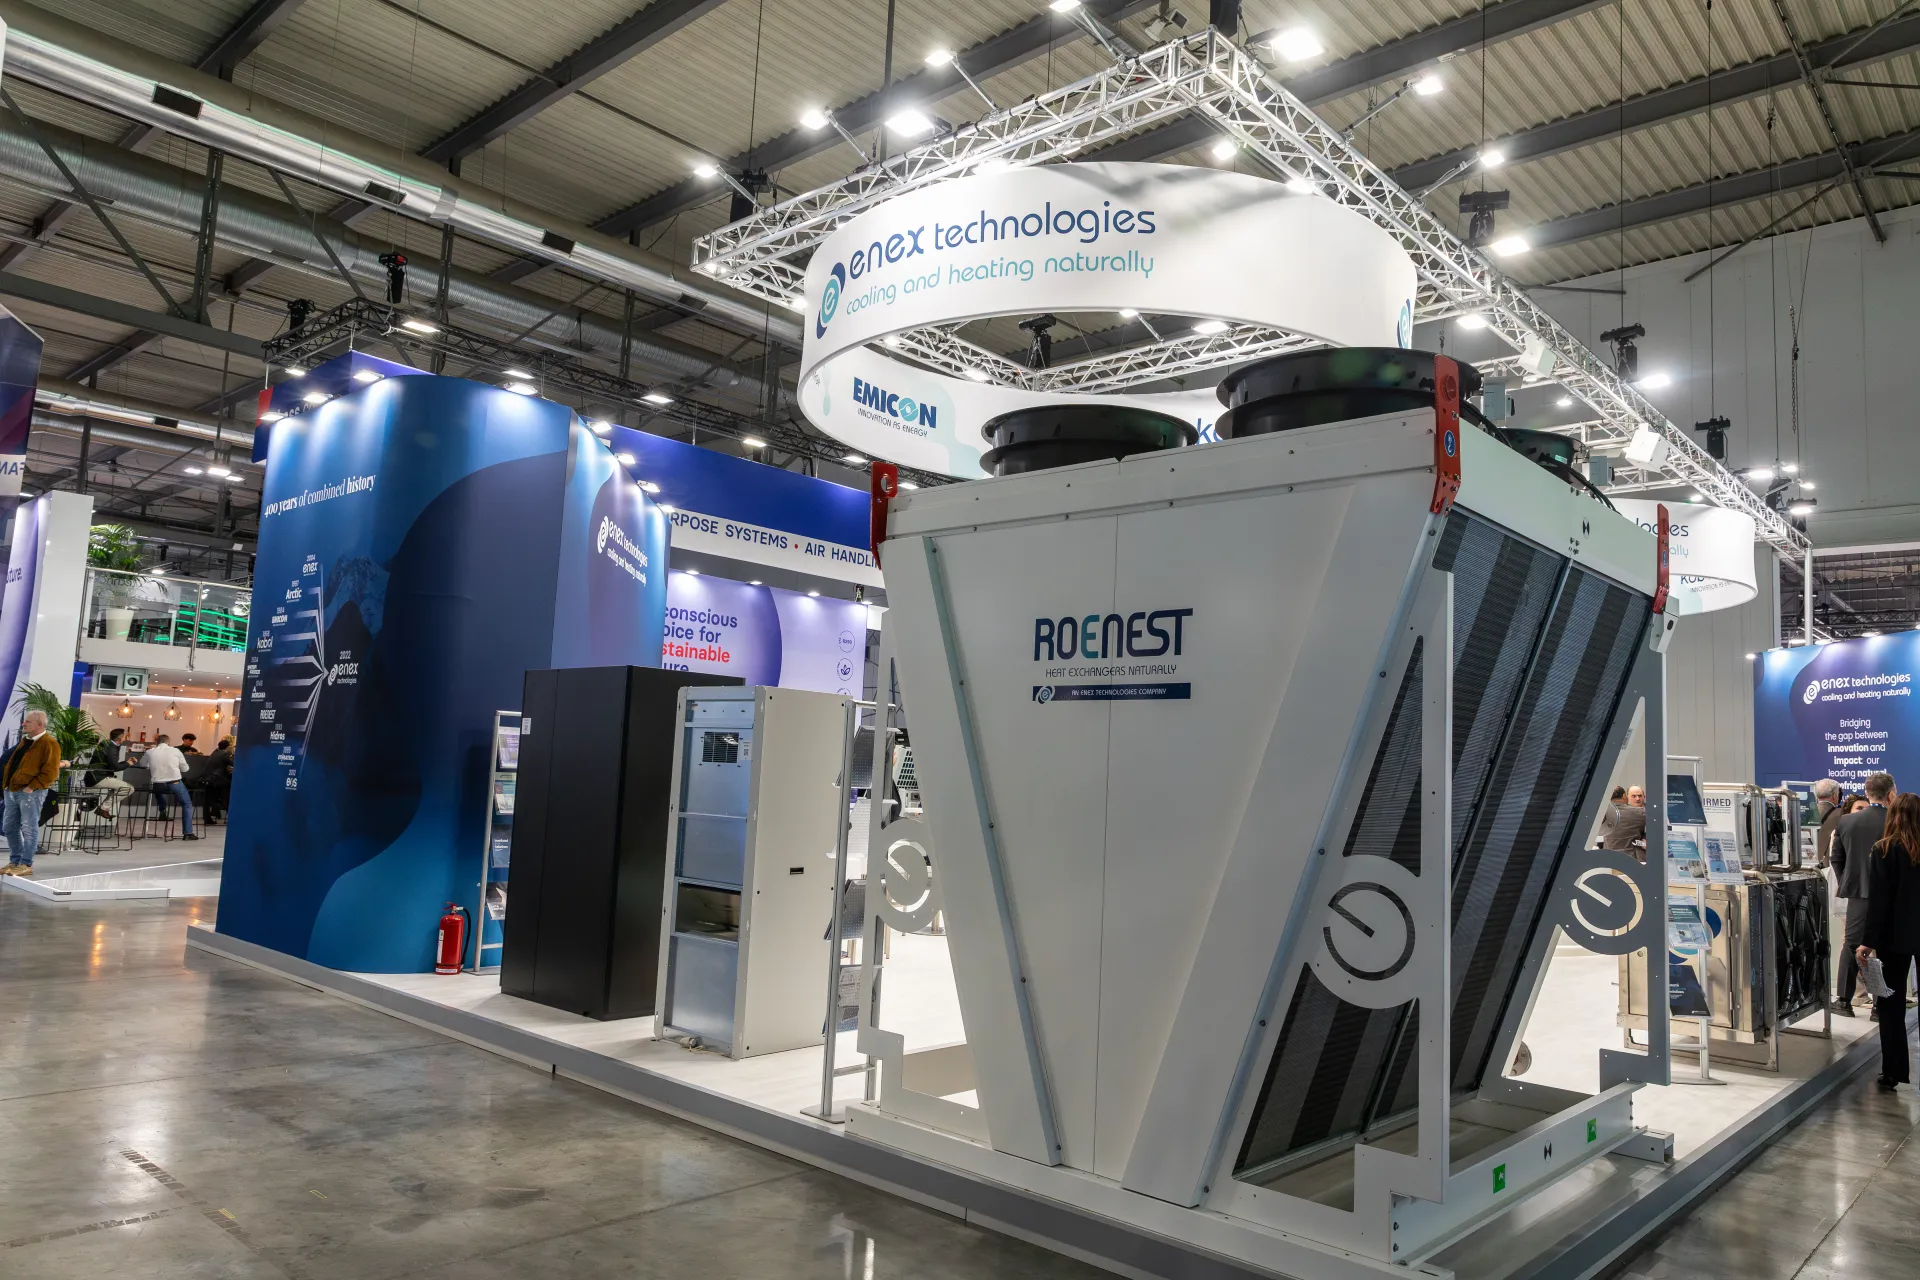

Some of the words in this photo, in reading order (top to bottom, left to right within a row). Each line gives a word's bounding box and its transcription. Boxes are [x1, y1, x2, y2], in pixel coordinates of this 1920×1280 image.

[850, 226, 924, 279] enex
[935, 201, 1156, 250] technologies
[846, 284, 896, 315] cooling
[904, 266, 940, 294] and
[949, 257, 1034, 284] heating
[1045, 250, 1154, 278] naturally
[853, 377, 937, 429] EMICON
[858, 408, 892, 426] INNOVATION
[893, 421, 900, 430] AS
[903, 425, 927, 438] ENERGY
[264, 504, 278, 518] 400
[278, 497, 298, 516] years
[299, 490, 308, 507] of
[308, 479, 346, 505] combined
[347, 475, 376, 495] history
[609, 521, 625, 547] enex
[624, 536, 648, 568] technologies
[725, 525, 788, 549] SYSTEMS
[805, 542, 825, 557] AIR
[832, 548, 877, 568] HANDLI
[303, 562, 318, 574] enex
[286, 588, 302, 600] Arctic
[699, 626, 721, 643] for
[1034, 608, 1193, 661] ROENEST
[340, 650, 351, 660] 2022
[339, 663, 359, 675] enex
[1046, 668, 1066, 678] HEAT
[1069, 666, 1126, 677] EXCHANGERS
[1129, 665, 1177, 676] NATURALLY
[1821, 678, 1850, 690] enex
[1852, 673, 1911, 687] technologies
[1822, 693, 1842, 702] cooling
[1844, 692, 1855, 700] and
[1857, 690, 1881, 700] heating
[1883, 687, 1911, 697] naturally
[1840, 718, 1871, 729] Bridging
[1825, 732, 1836, 740] the
[1838, 733, 1853, 742] gap
[1855, 731, 1888, 739] between
[1828, 743, 1869, 752] innovation
[1870, 743, 1886, 752] and
[1828, 769, 1856, 780] leading
